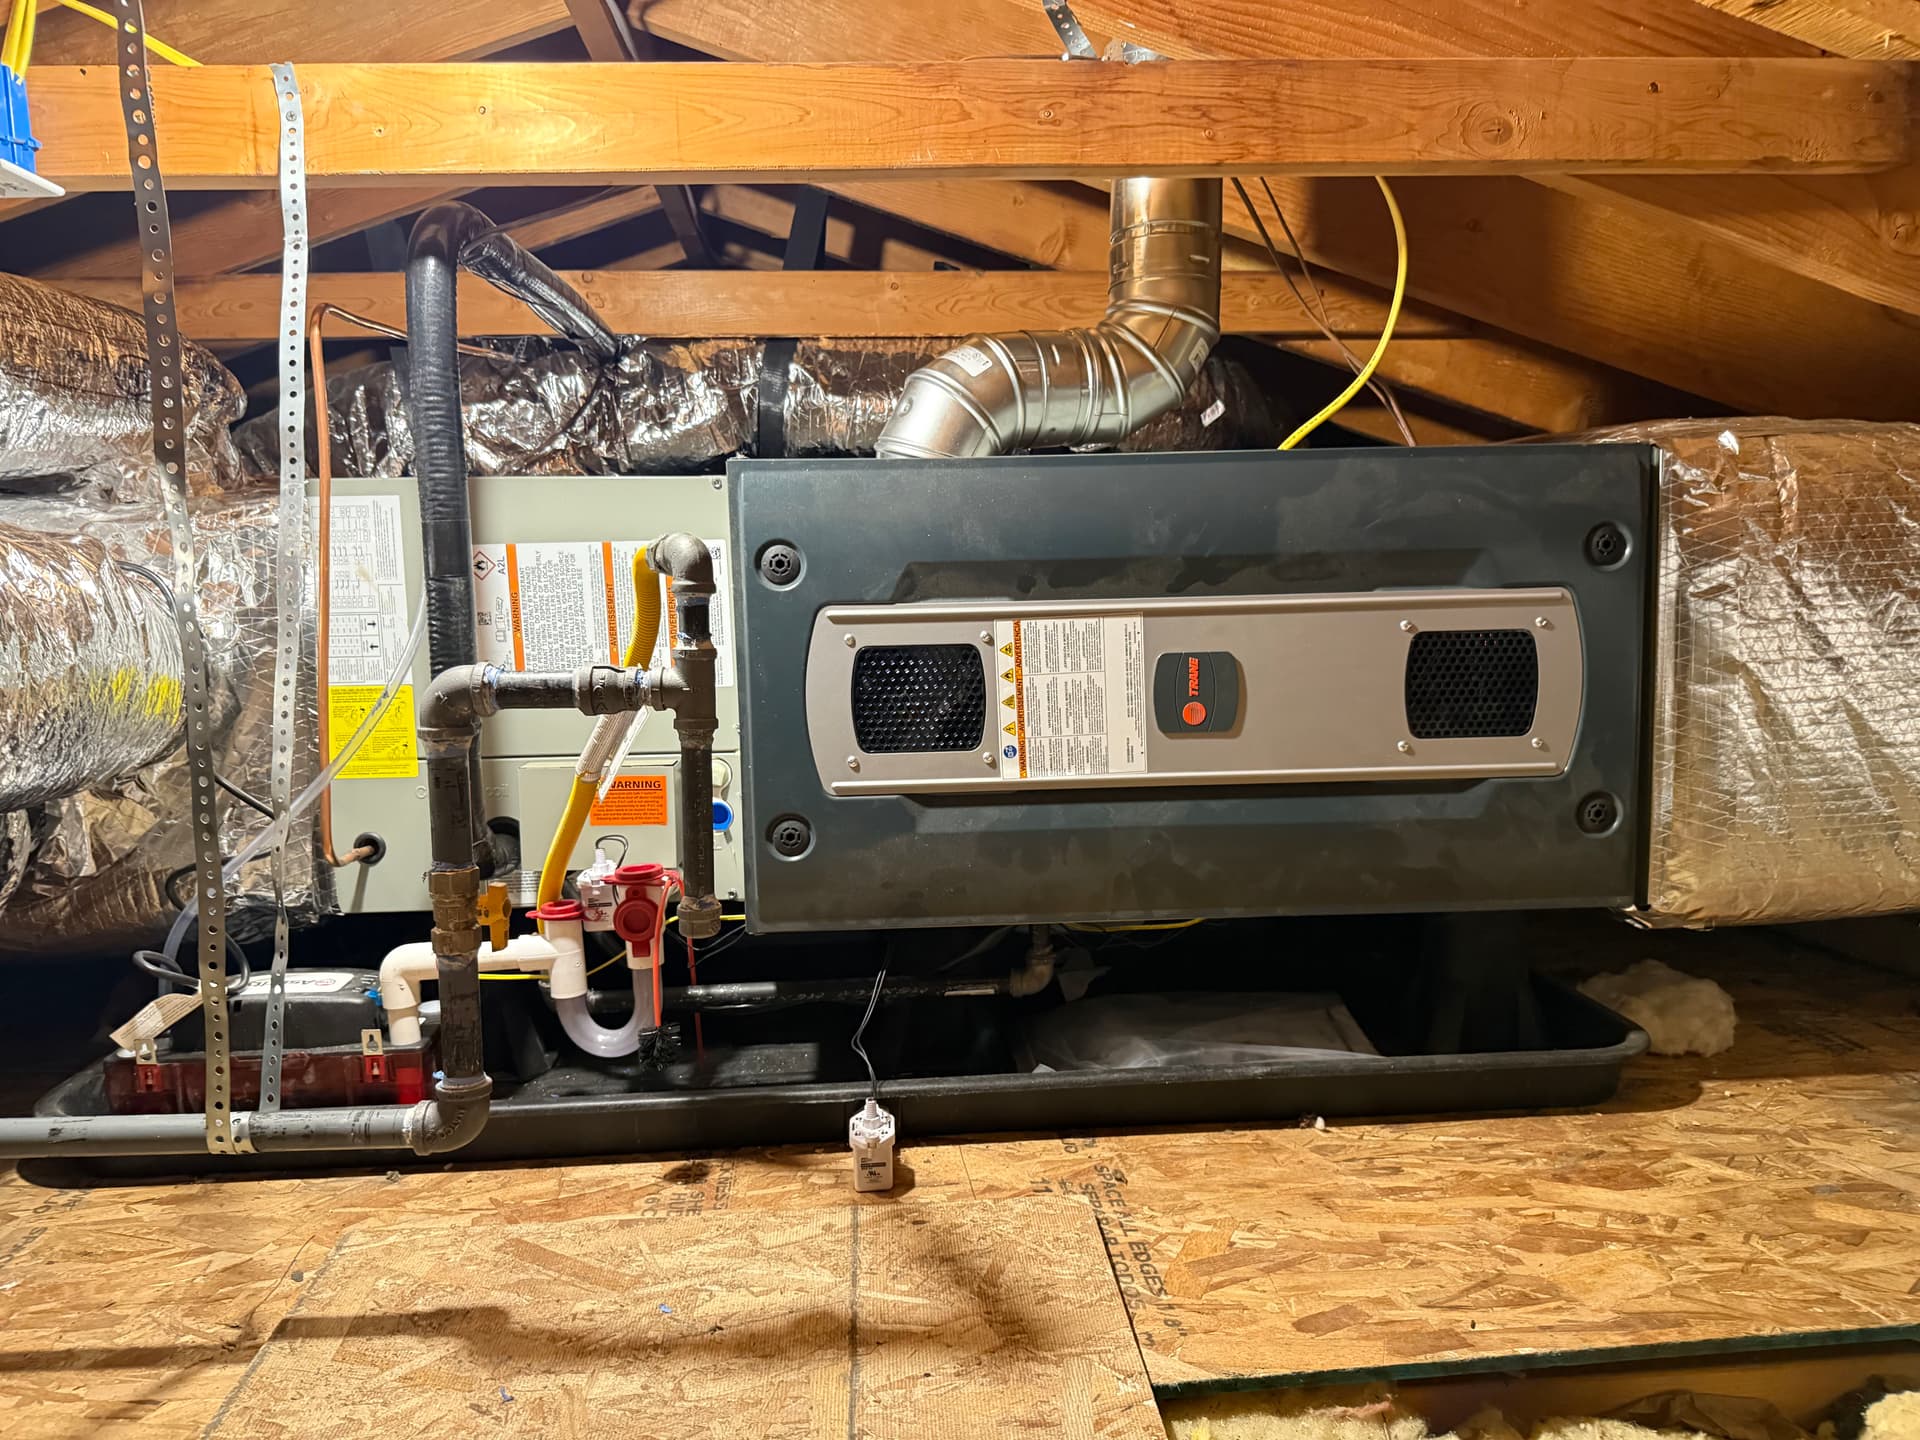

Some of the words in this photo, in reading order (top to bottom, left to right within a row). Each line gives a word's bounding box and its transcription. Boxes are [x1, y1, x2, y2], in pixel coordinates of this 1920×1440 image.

[497, 556, 506, 575] A2L
[530, 565, 538, 598] PUNCTURE
[535, 549, 543, 582] PROPERLY
[519, 567, 527, 610] REFRIGERANT
[527, 594, 532, 602] BY
[538, 584, 543, 592] OF
[543, 584, 549, 592] OR
[511, 592, 521, 633] WARNING
[534, 614, 540, 623] DO
[555, 591, 563, 622] AUXILIARY
[562, 605, 570, 639] POTENTIAL
[606, 583, 618, 646] AVERTISSEMENT
[522, 612, 530, 649] FLAMMABLE
[568, 611, 576, 644] INSTALLED
[574, 618, 582, 649] AUXILIARY
[1014, 620, 1022, 668] ADVERTENCIA
[565, 646, 570, 654] BE
[571, 645, 576, 654] BE
[1188, 657, 1200, 697] TRANE
[1017, 678, 1025, 731] AVERTISSEMENT
[1094, 1164, 1127, 1208] SPACE
[1115, 1209, 1138, 1237] ALL
[1127, 1240, 1169, 1298] EDGES
